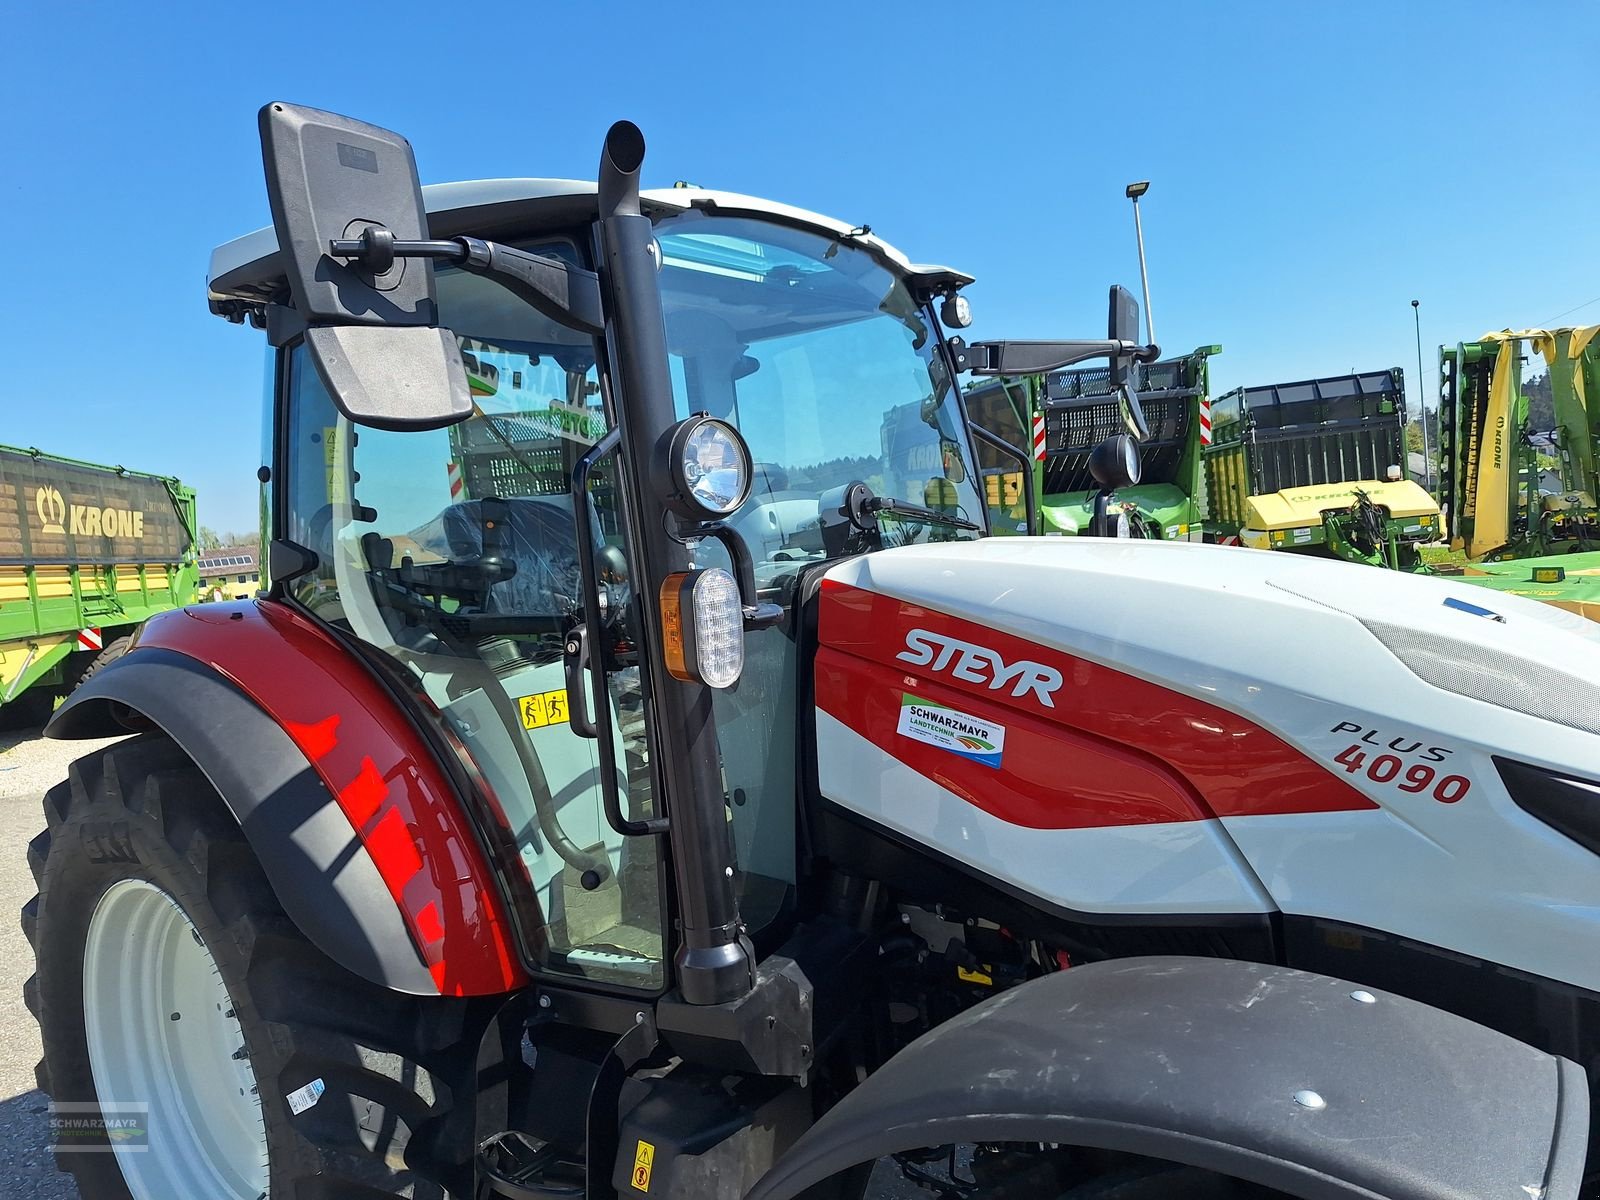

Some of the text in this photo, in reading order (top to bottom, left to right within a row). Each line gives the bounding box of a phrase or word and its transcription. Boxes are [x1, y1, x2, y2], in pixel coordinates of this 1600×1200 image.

[1493, 429, 1502, 469] KRONE
[70, 504, 144, 538] KRONE
[895, 628, 1064, 708] STEYR
[910, 706, 989, 739] SCHWARZMAYR
[910, 717, 955, 738] LANDTECHNIK
[1330, 721, 1453, 762] PLUS
[1333, 744, 1471, 804] 4090
